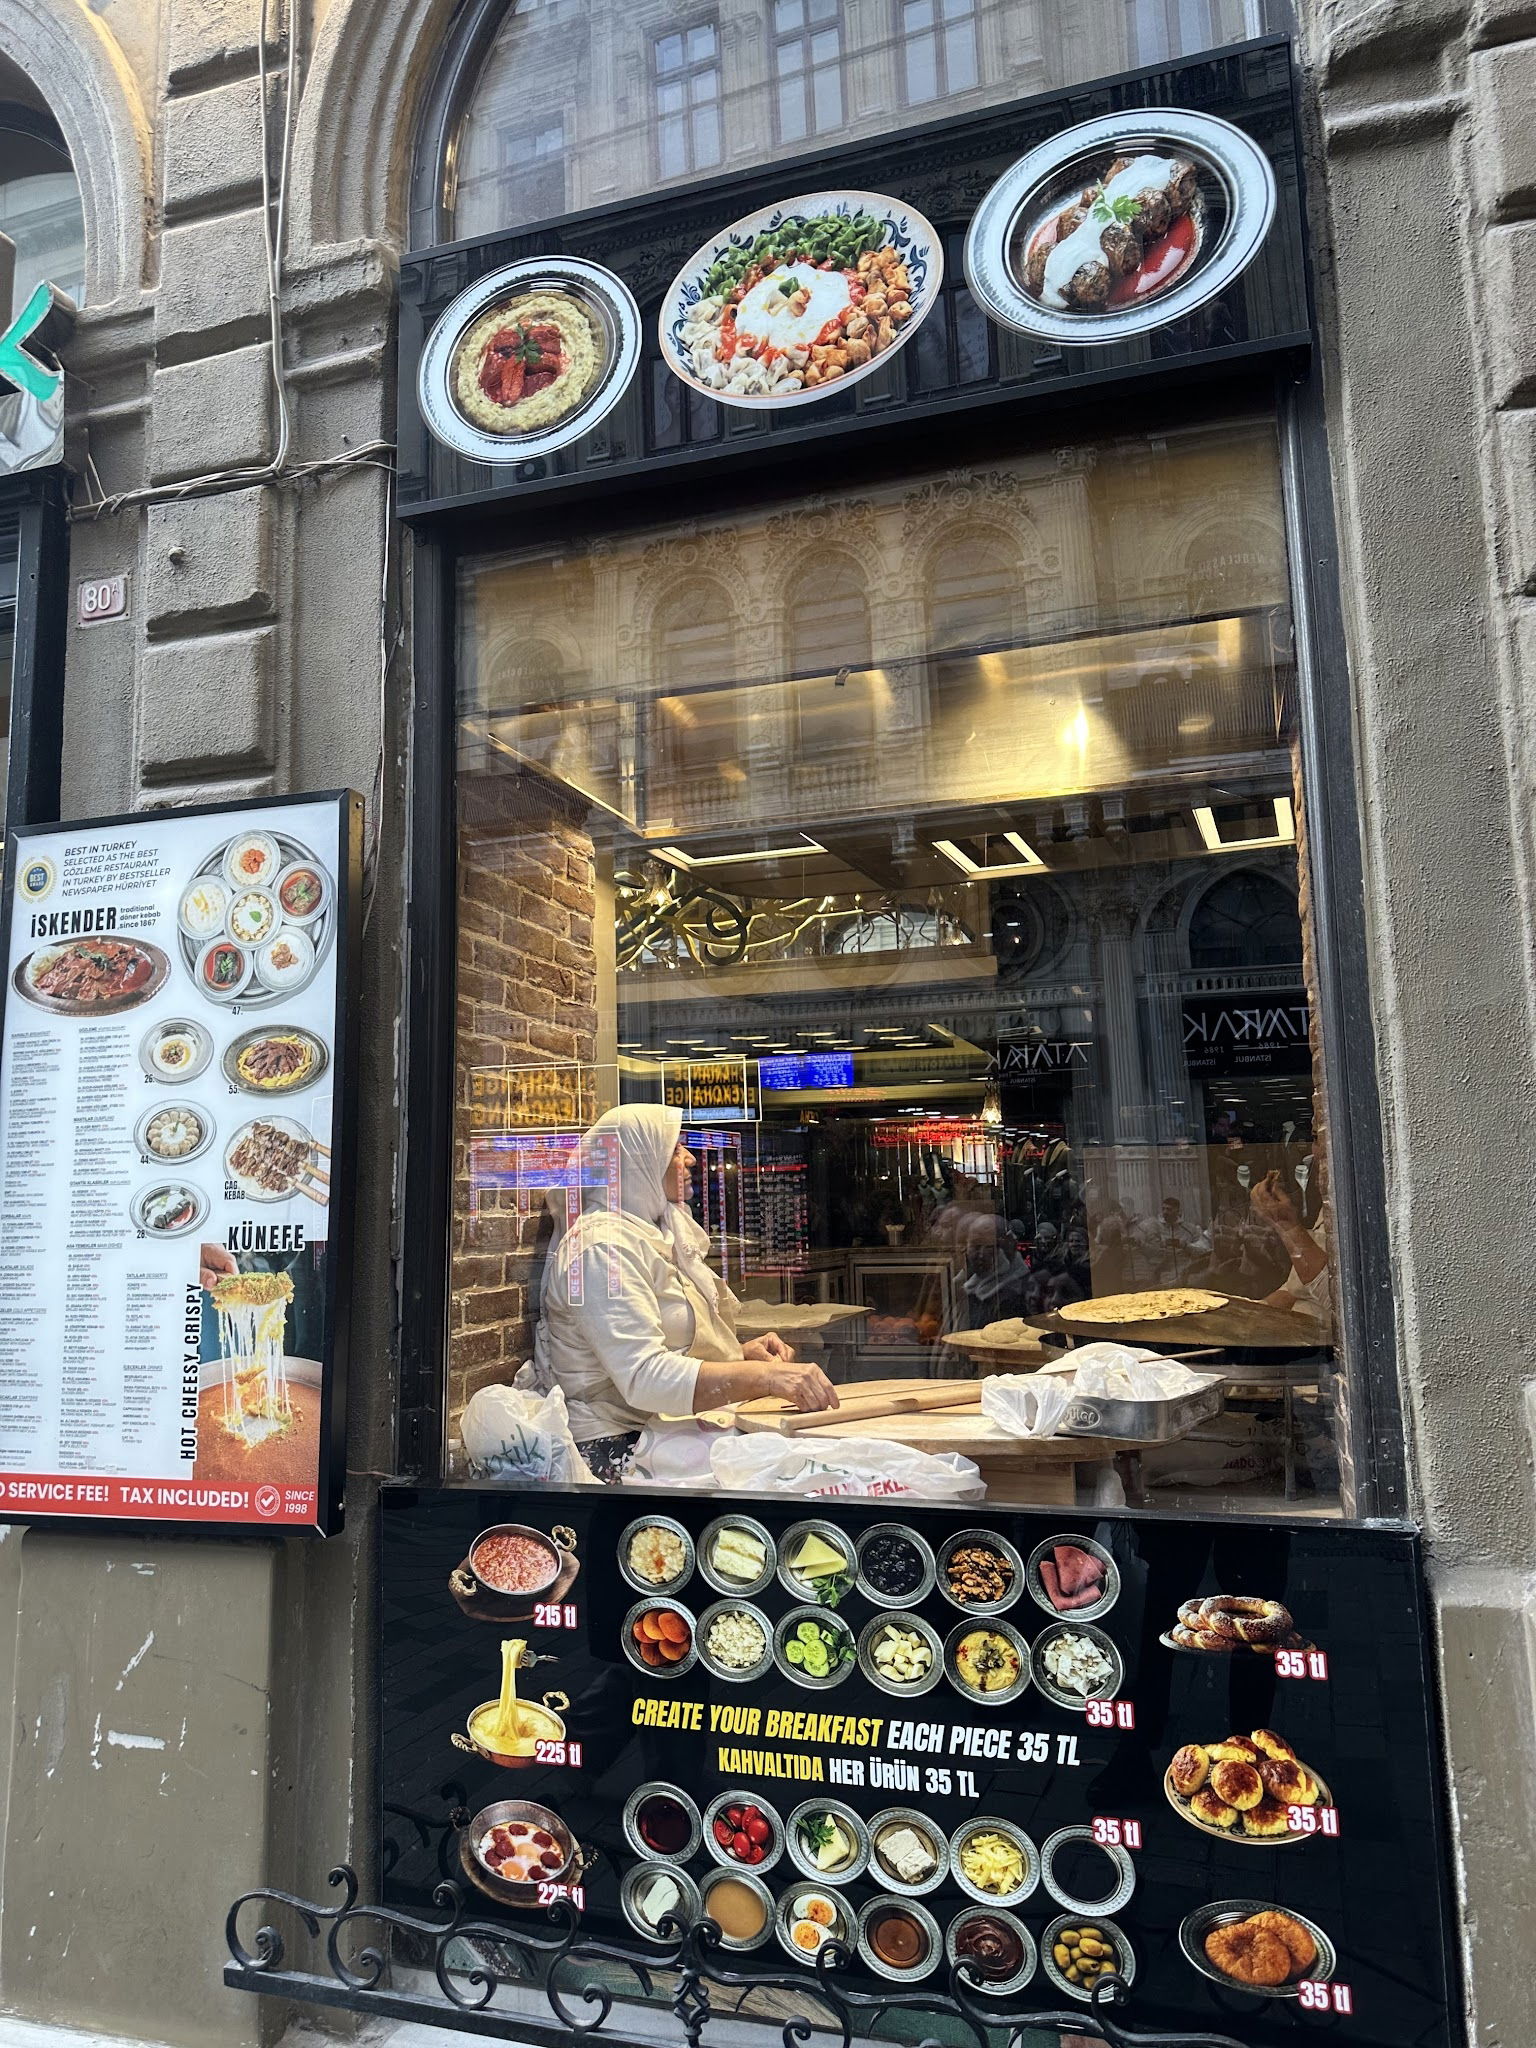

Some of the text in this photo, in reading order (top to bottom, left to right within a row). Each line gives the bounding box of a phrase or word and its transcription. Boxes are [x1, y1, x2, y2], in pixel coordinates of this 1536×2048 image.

[64, 840, 138, 857] BEST IN TURKEY
[64, 849, 158, 867] SELECTED AS THE BEST
[104, 859, 159, 872] RESTAURANT
[62, 868, 171, 887] IN TURKEY BY BESTSELLER
[62, 884, 113, 897] NEWSPAPER
[120, 904, 154, 913] traditional
[120, 910, 161, 921] döner kebab
[119, 919, 156, 929] since 1867
[224, 1190, 246, 1200] KEBAB
[228, 1221, 304, 1250] KÜNEFE
[180, 1283, 202, 1460] HOT CHEESY CRISPY
[8, 1482, 73, 1500] SERVICE
[77, 1485, 110, 1502] FEE!
[120, 1487, 154, 1505] TAX
[157, 1488, 249, 1509] INCLUDED!
[285, 1490, 315, 1501] SINCE
[285, 1503, 308, 1514] 1998
[534, 1604, 561, 1627] 215
[1276, 1651, 1305, 1677] 35
[1086, 1701, 1114, 1727] 35
[631, 1698, 1081, 1766] CREATE YOUR BREAKFAST EACH PIECE 35 TL
[536, 1740, 566, 1764] 225
[718, 1747, 980, 1798] KAHVALTIDA HER ÜRÜN 35 TL
[1287, 1805, 1316, 1832] 35
[1093, 1819, 1120, 1844] 35
[1300, 1980, 1329, 2009] 35
